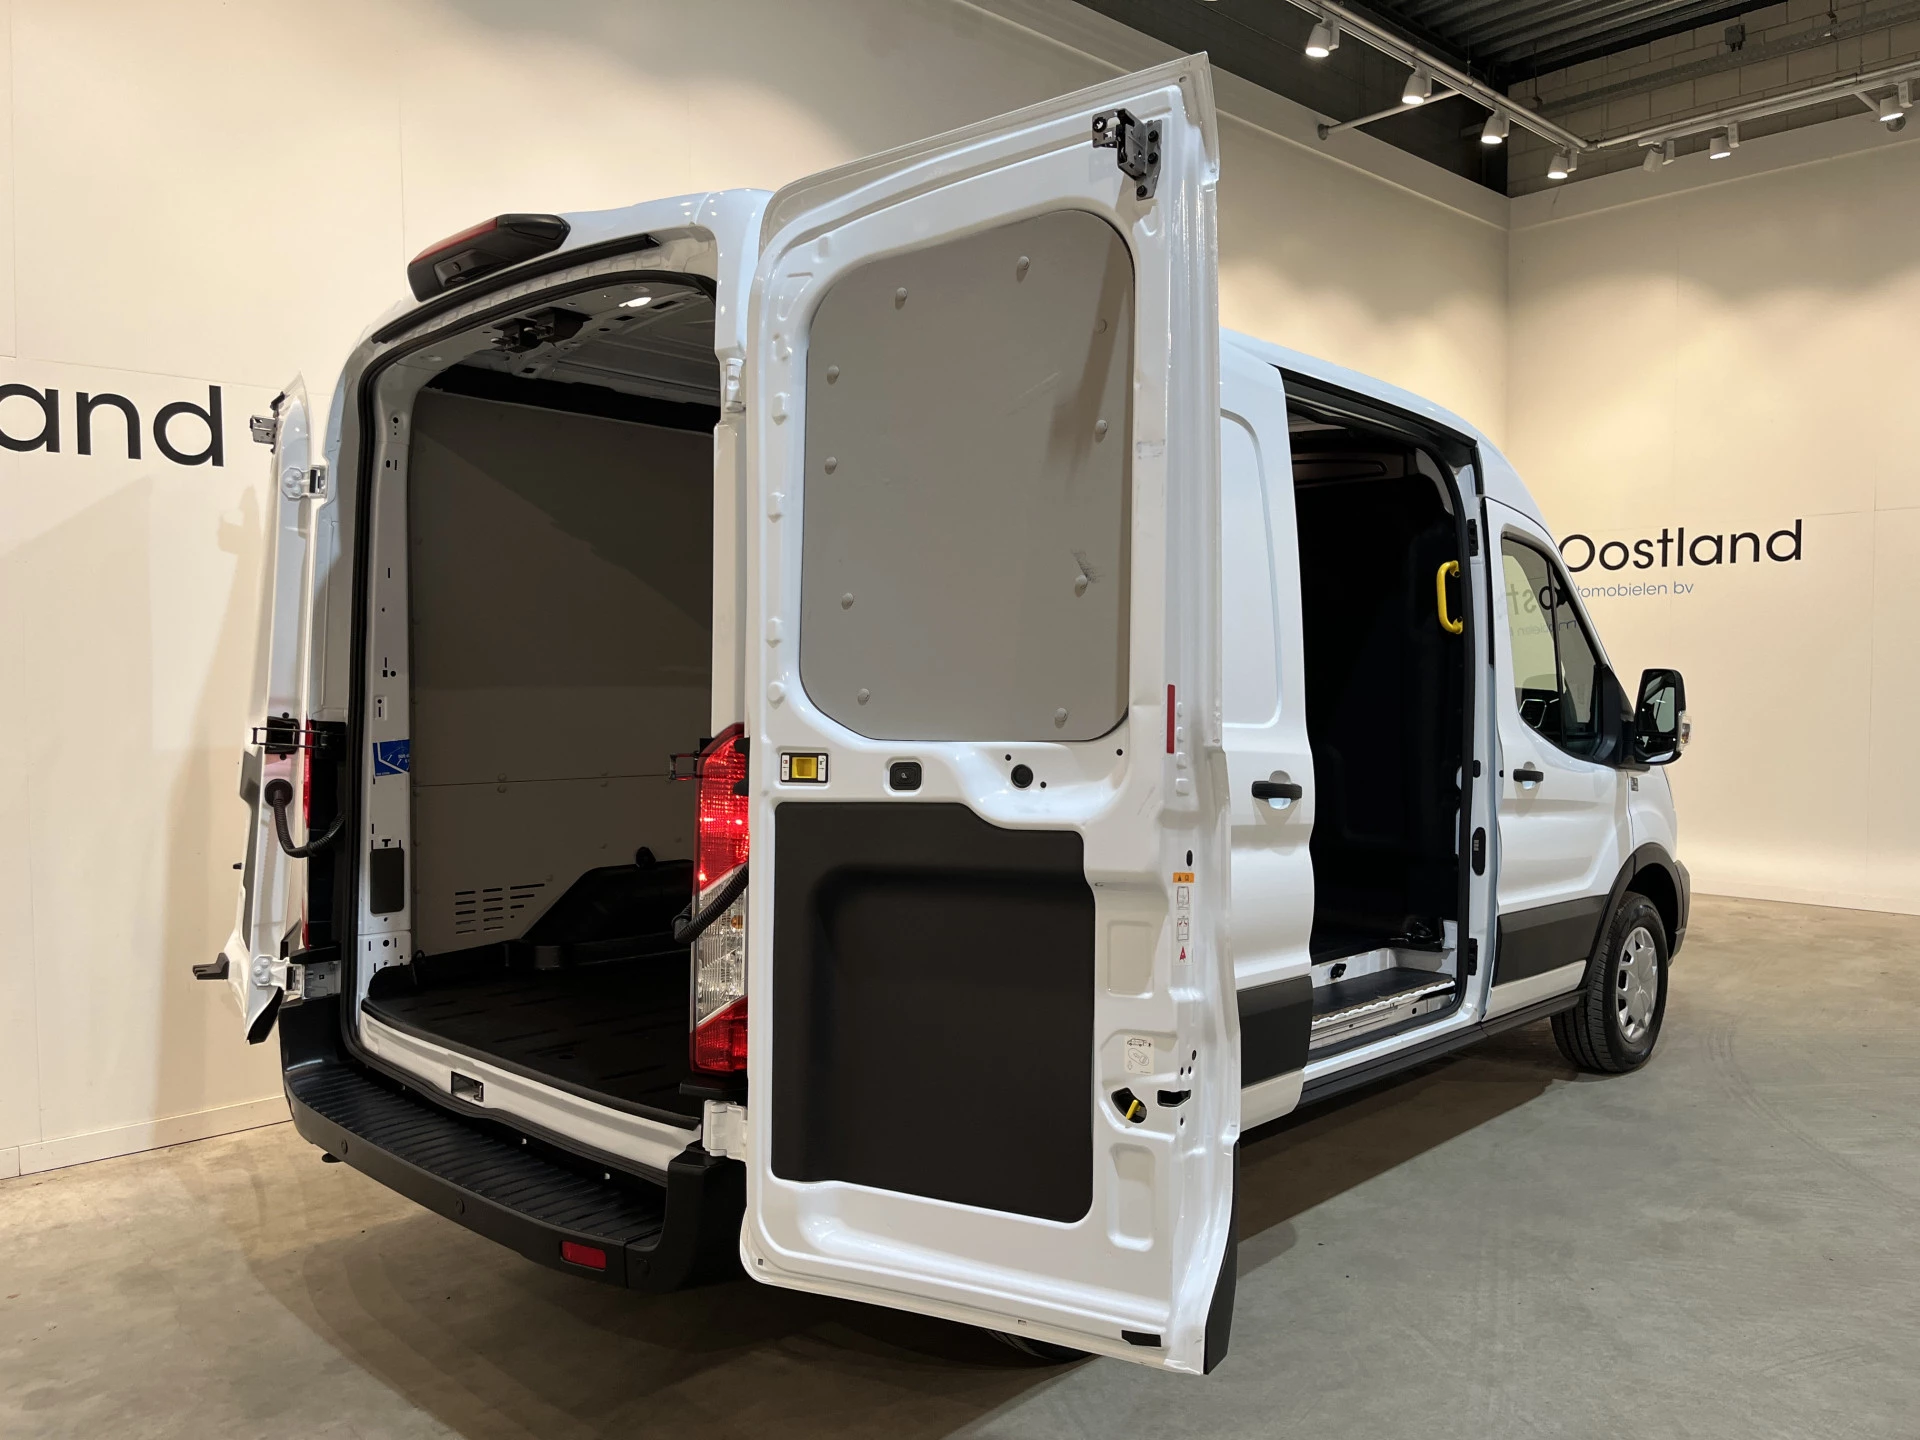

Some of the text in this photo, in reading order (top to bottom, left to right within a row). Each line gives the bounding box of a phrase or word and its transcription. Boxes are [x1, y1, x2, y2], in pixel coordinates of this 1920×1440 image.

[0, 383, 224, 467] and
[1560, 518, 1802, 573] Oostland
[1674, 581, 1695, 594] bv
